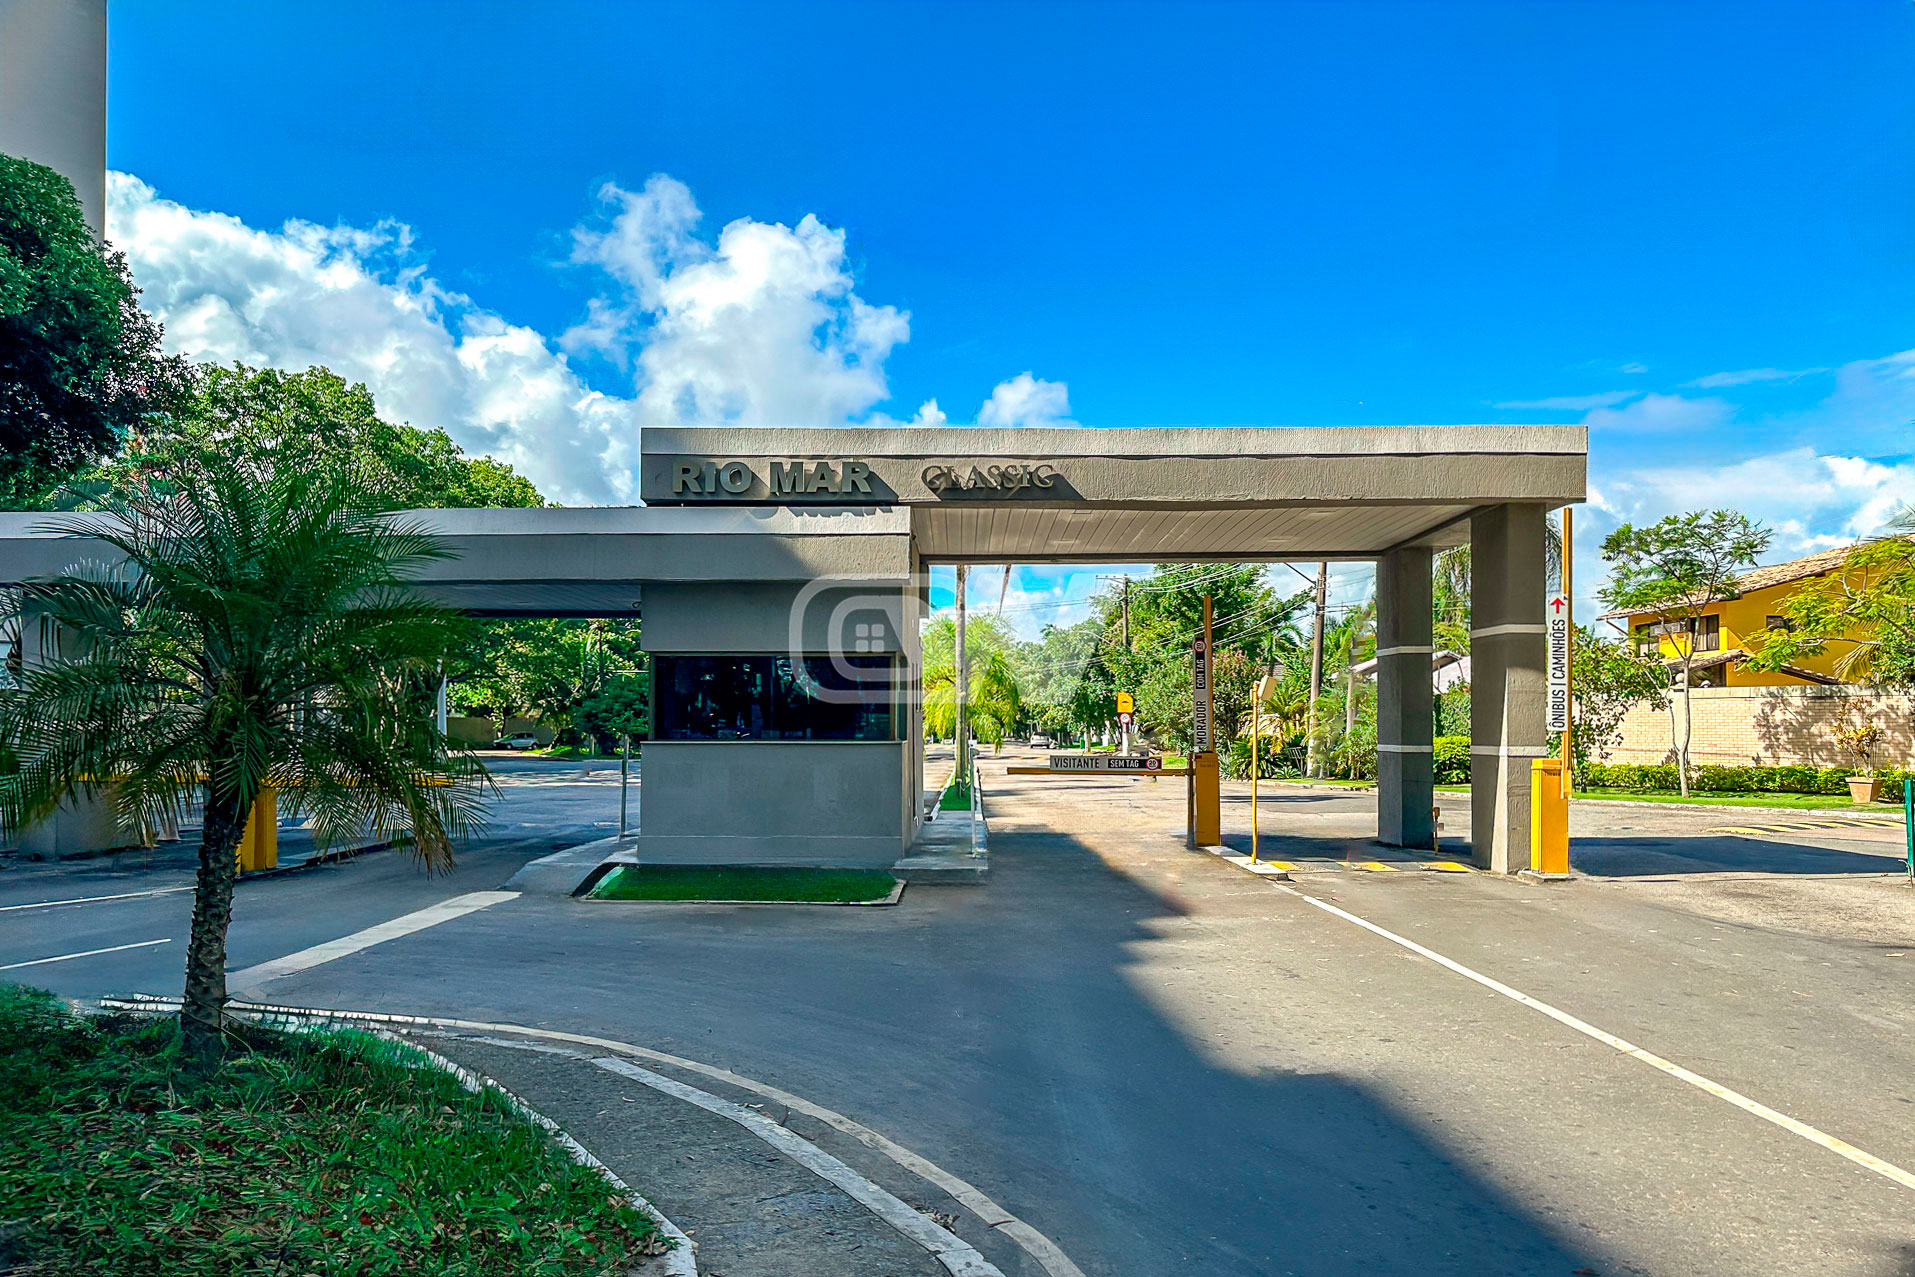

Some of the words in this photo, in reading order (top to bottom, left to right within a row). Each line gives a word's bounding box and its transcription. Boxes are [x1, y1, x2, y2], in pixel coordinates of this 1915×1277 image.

[672, 461, 752, 494] RIO
[769, 461, 873, 494] MAR
[921, 464, 1054, 489] CLASSIC
[1549, 619, 1566, 679] CAMINHÕES
[1196, 700, 1207, 745] MORADOR
[1549, 689, 1566, 728] ÔNIBUS
[1054, 757, 1100, 769] VISITANTE
[1110, 759, 1125, 768] SEM
[1126, 759, 1140, 768] TAG
